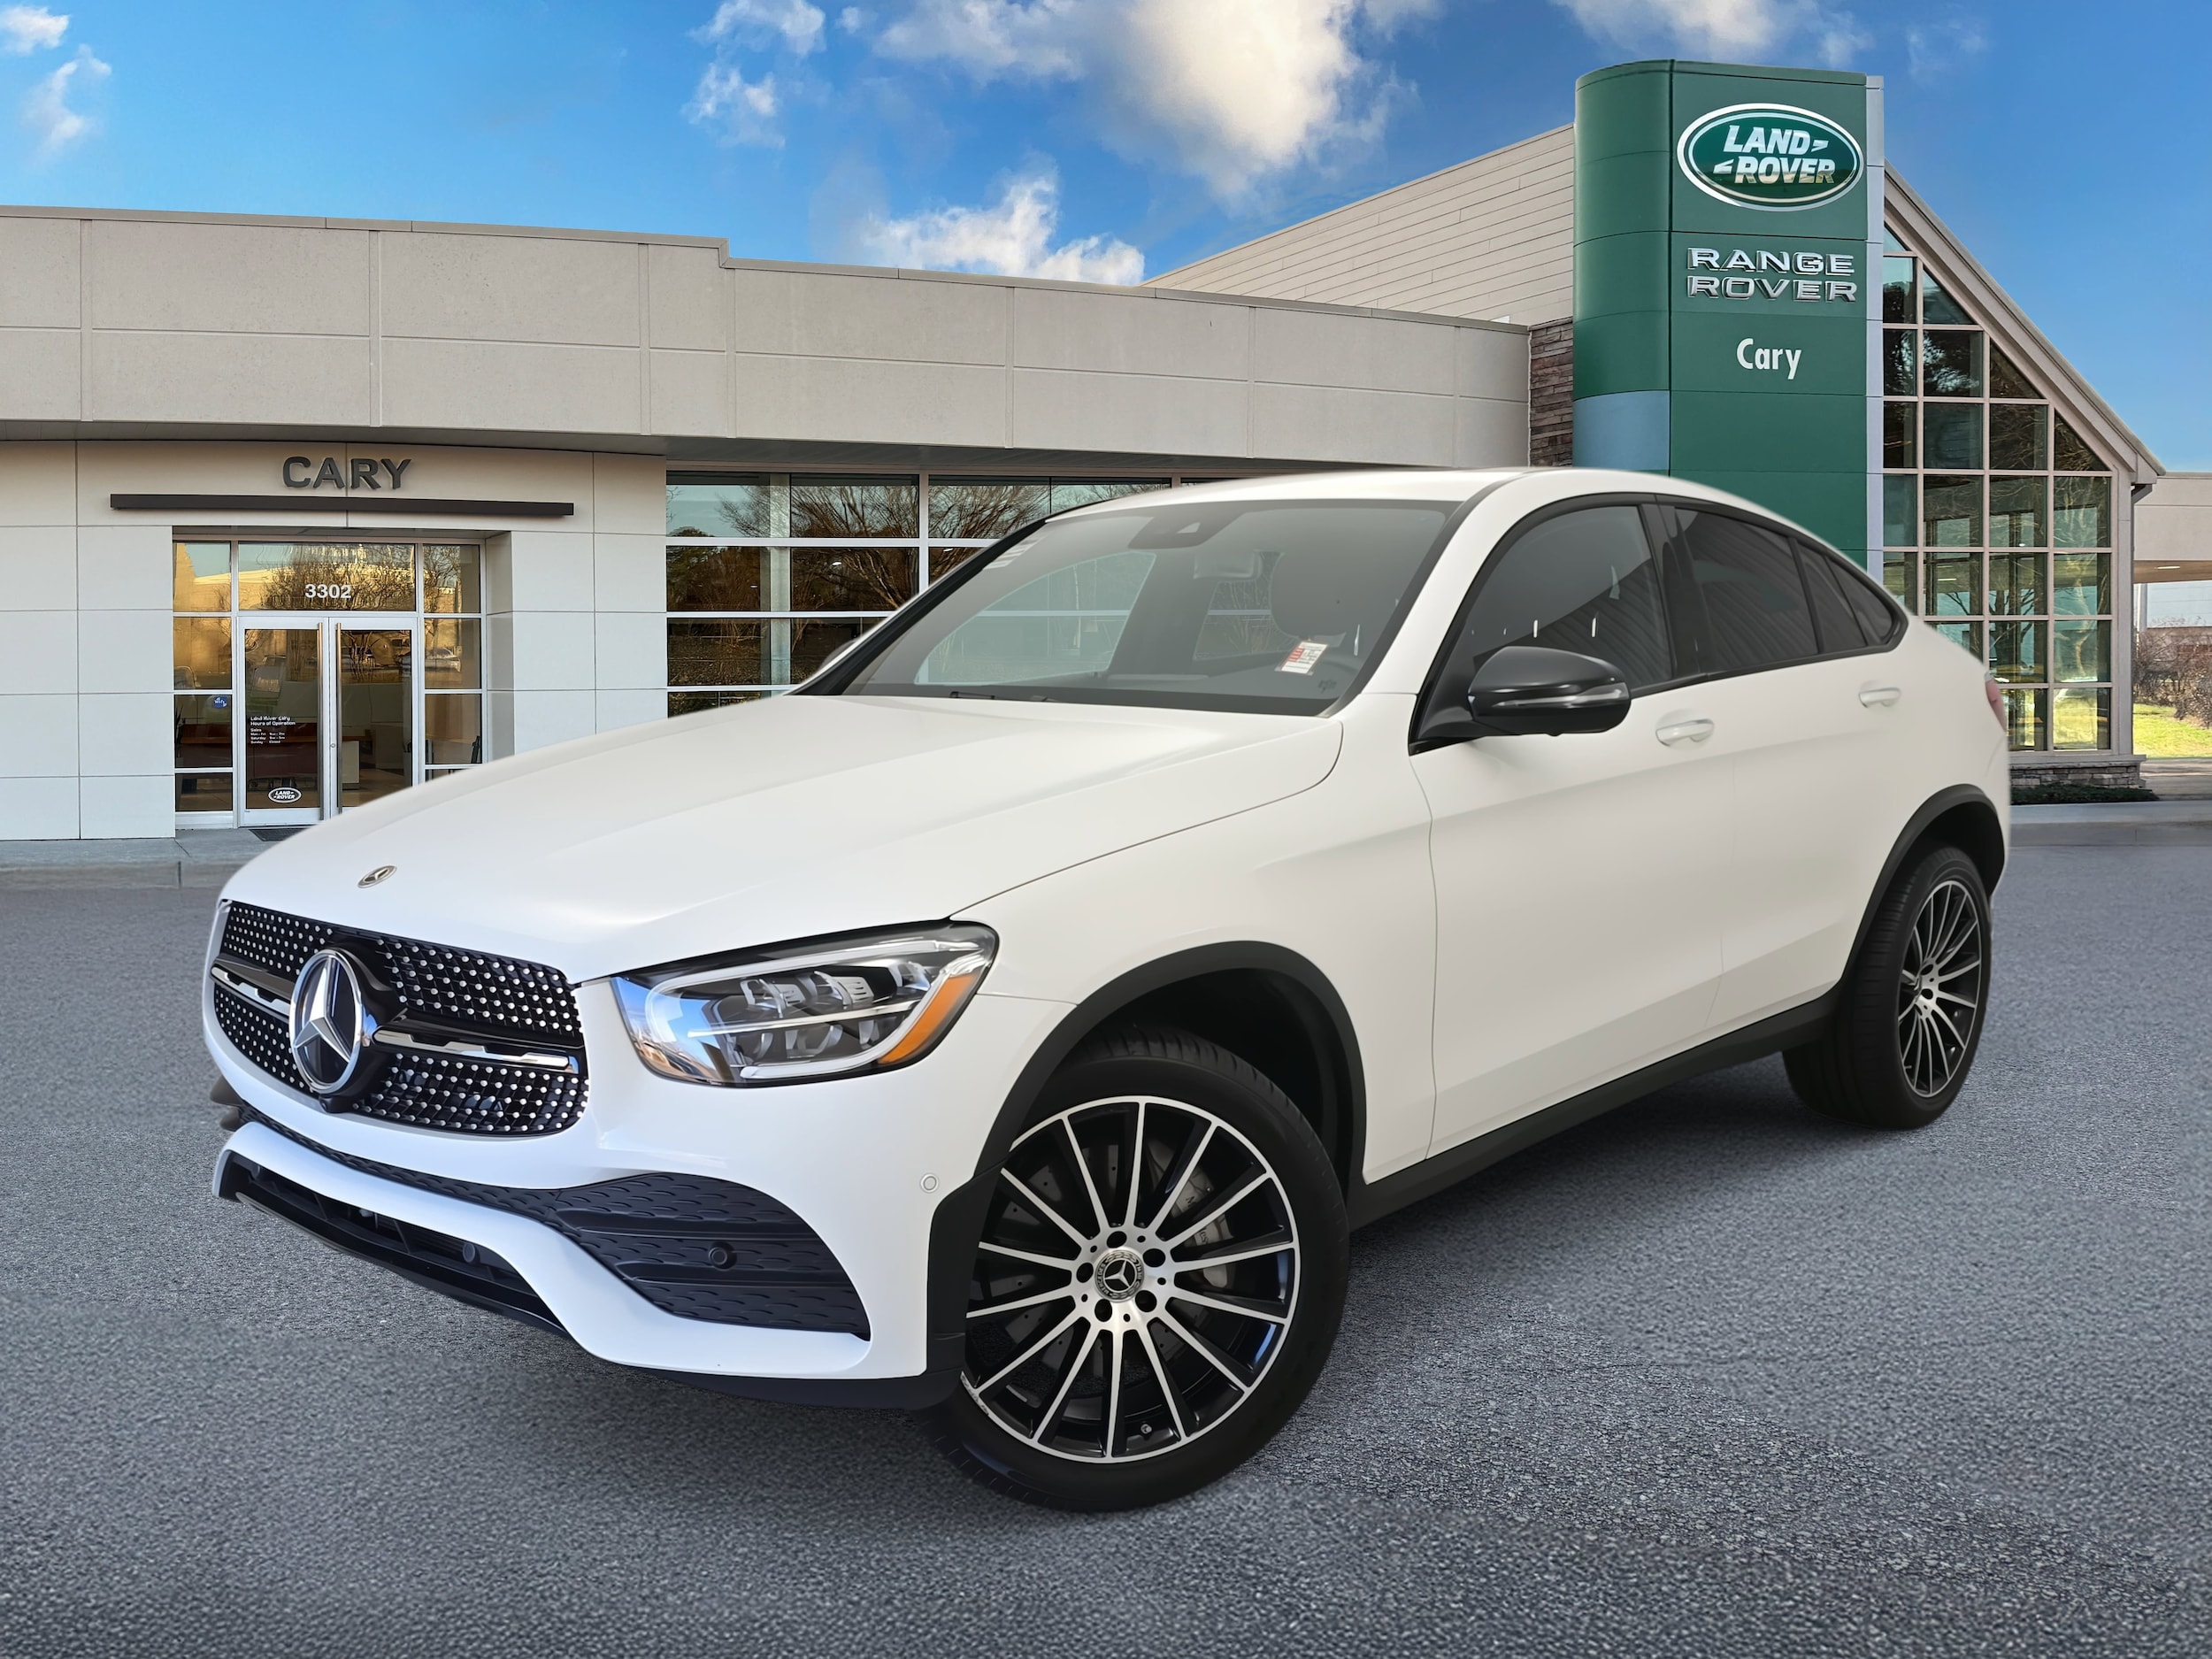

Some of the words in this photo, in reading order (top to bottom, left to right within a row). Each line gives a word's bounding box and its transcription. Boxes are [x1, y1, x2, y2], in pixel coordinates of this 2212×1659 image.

[1724, 125, 1810, 155] LAND
[1733, 156, 1836, 184] ROVER
[1686, 247, 1856, 276] RANGE
[1686, 275, 1858, 303] ROVER
[1736, 338, 1802, 380] Cary
[282, 456, 412, 490] CARY
[304, 583, 352, 599] 3302
